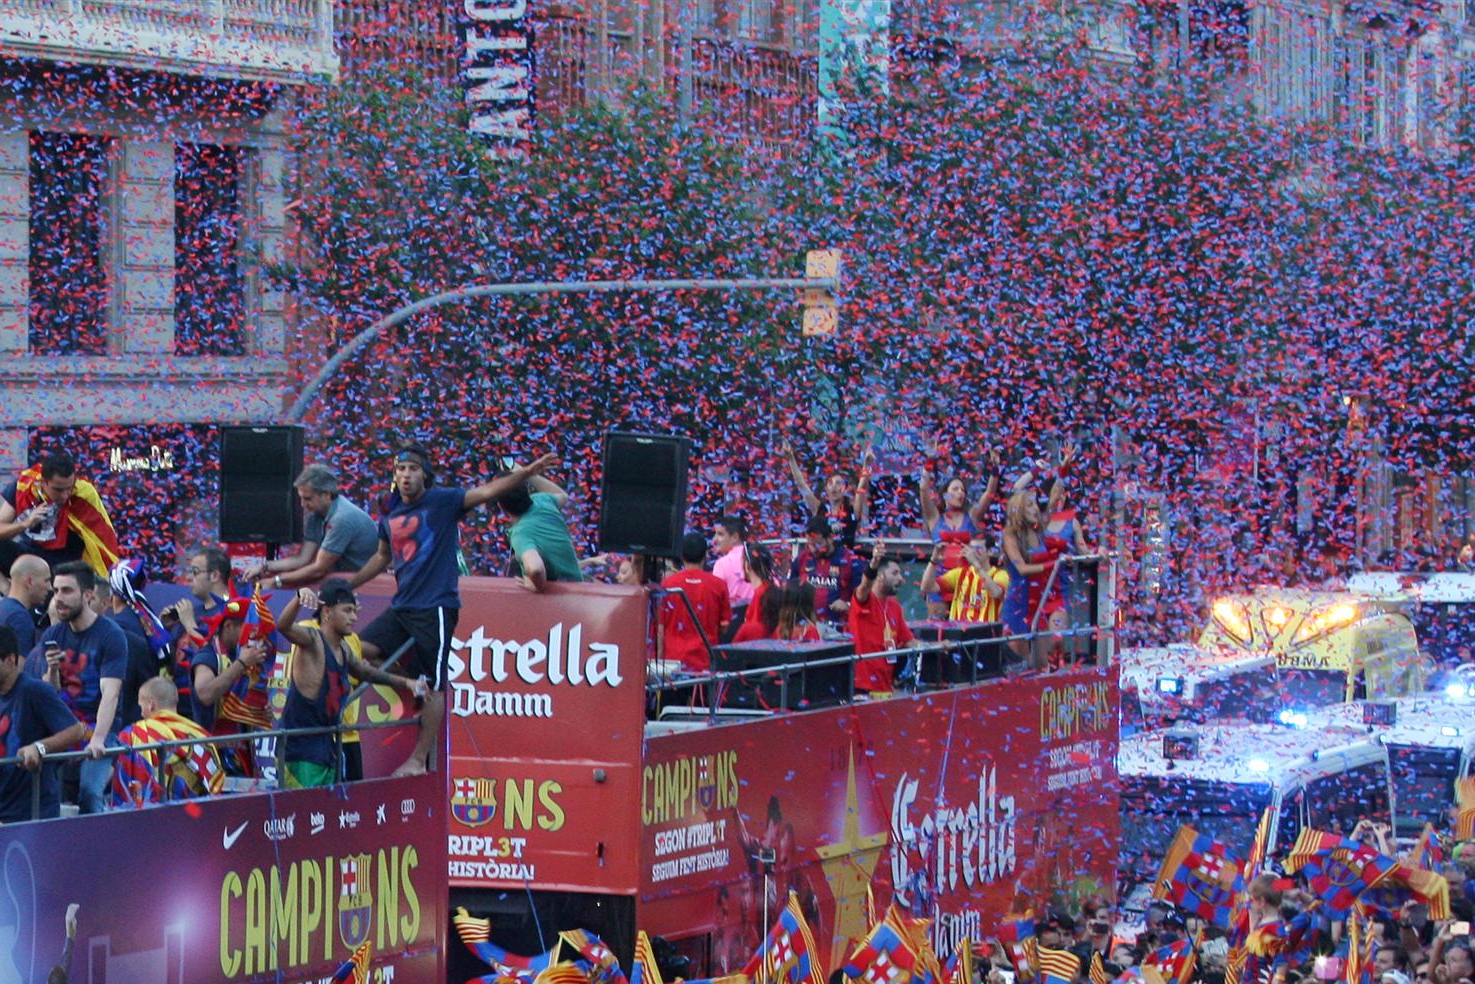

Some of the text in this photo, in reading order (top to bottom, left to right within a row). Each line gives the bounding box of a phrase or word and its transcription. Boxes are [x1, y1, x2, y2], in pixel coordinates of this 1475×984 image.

[449, 622, 623, 688] strella
[450, 682, 554, 718] Damm
[642, 748, 739, 827] CAMPINS
[220, 844, 419, 979] CAMPINS
